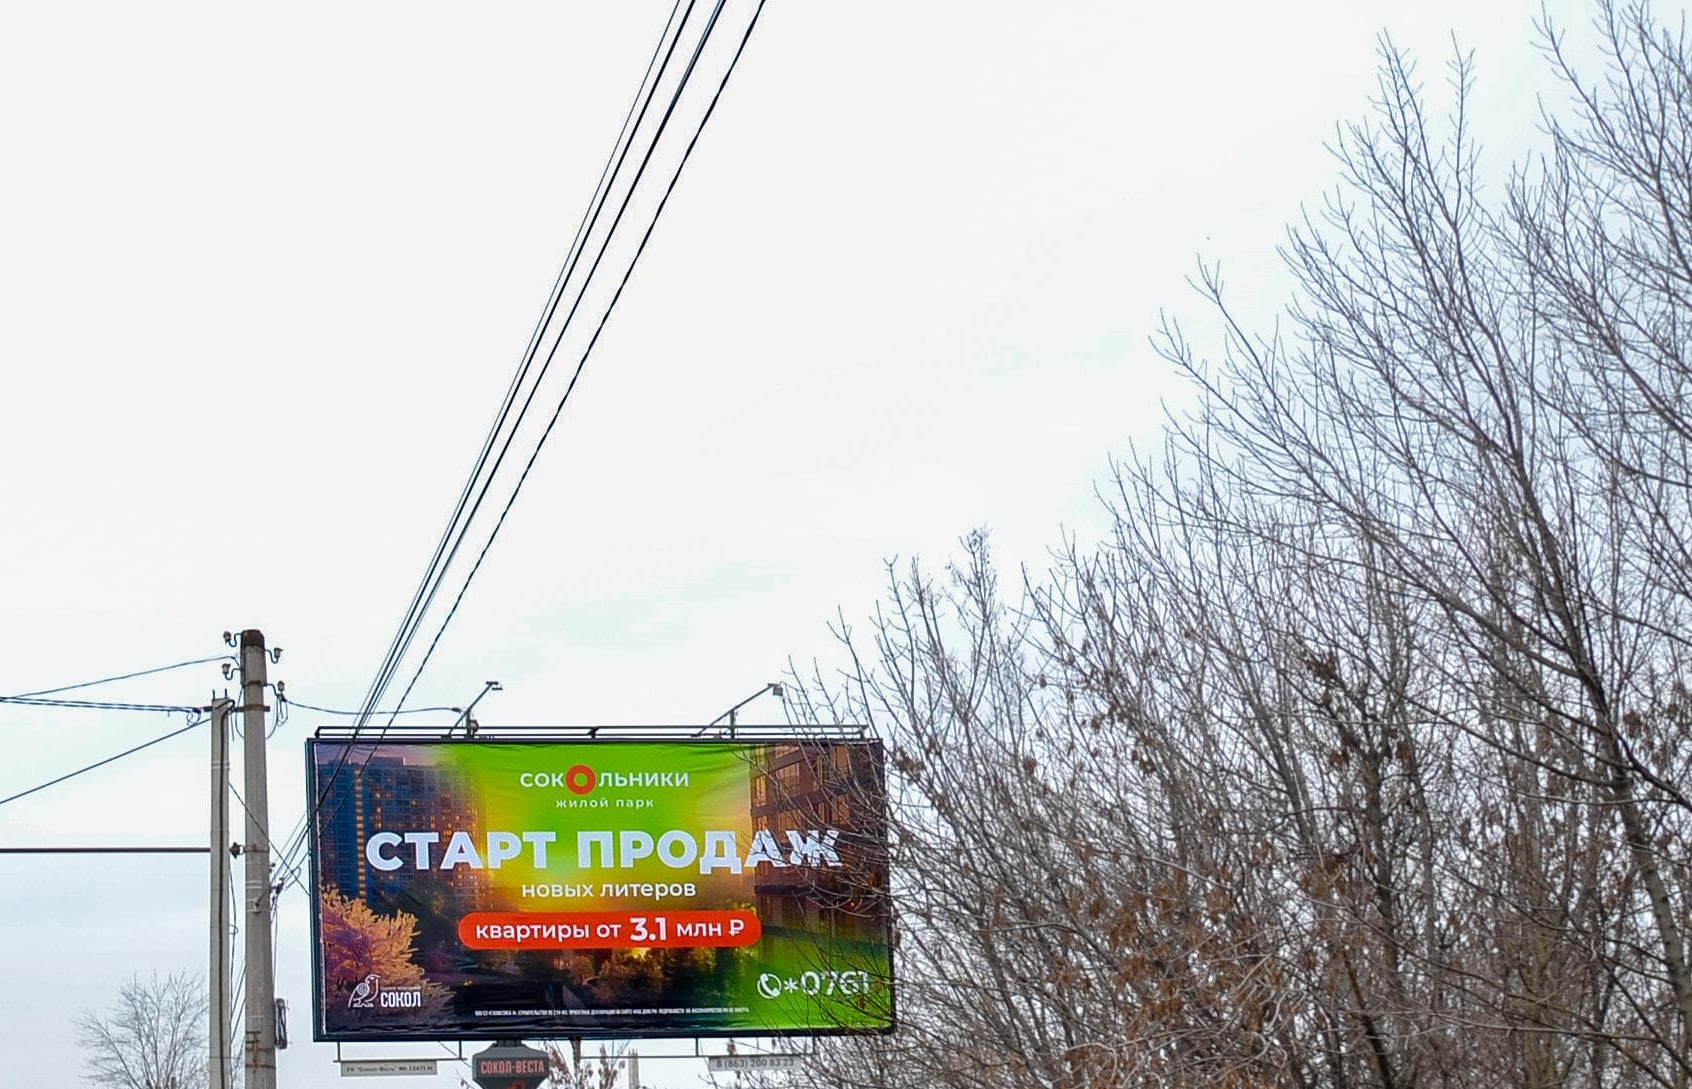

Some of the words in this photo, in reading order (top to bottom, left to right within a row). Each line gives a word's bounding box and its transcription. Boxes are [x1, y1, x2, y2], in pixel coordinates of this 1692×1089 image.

[519, 764, 690, 795] СОКОЛЬНИКИ
[555, 797, 609, 808] жилой
[615, 798, 654, 810] парк
[365, 831, 557, 872] СТАРТ
[576, 829, 843, 875] ПРОДАЖ
[521, 884, 594, 898] новых
[599, 882, 697, 900] литеров
[475, 924, 590, 942] квартиры
[595, 924, 622, 938] от
[629, 917, 668, 941] 3.1
[676, 922, 723, 938] млн
[380, 991, 422, 1008] СОКОЛ
[480, 1060, 545, 1074] СОКОЛ-ВЕСТА
